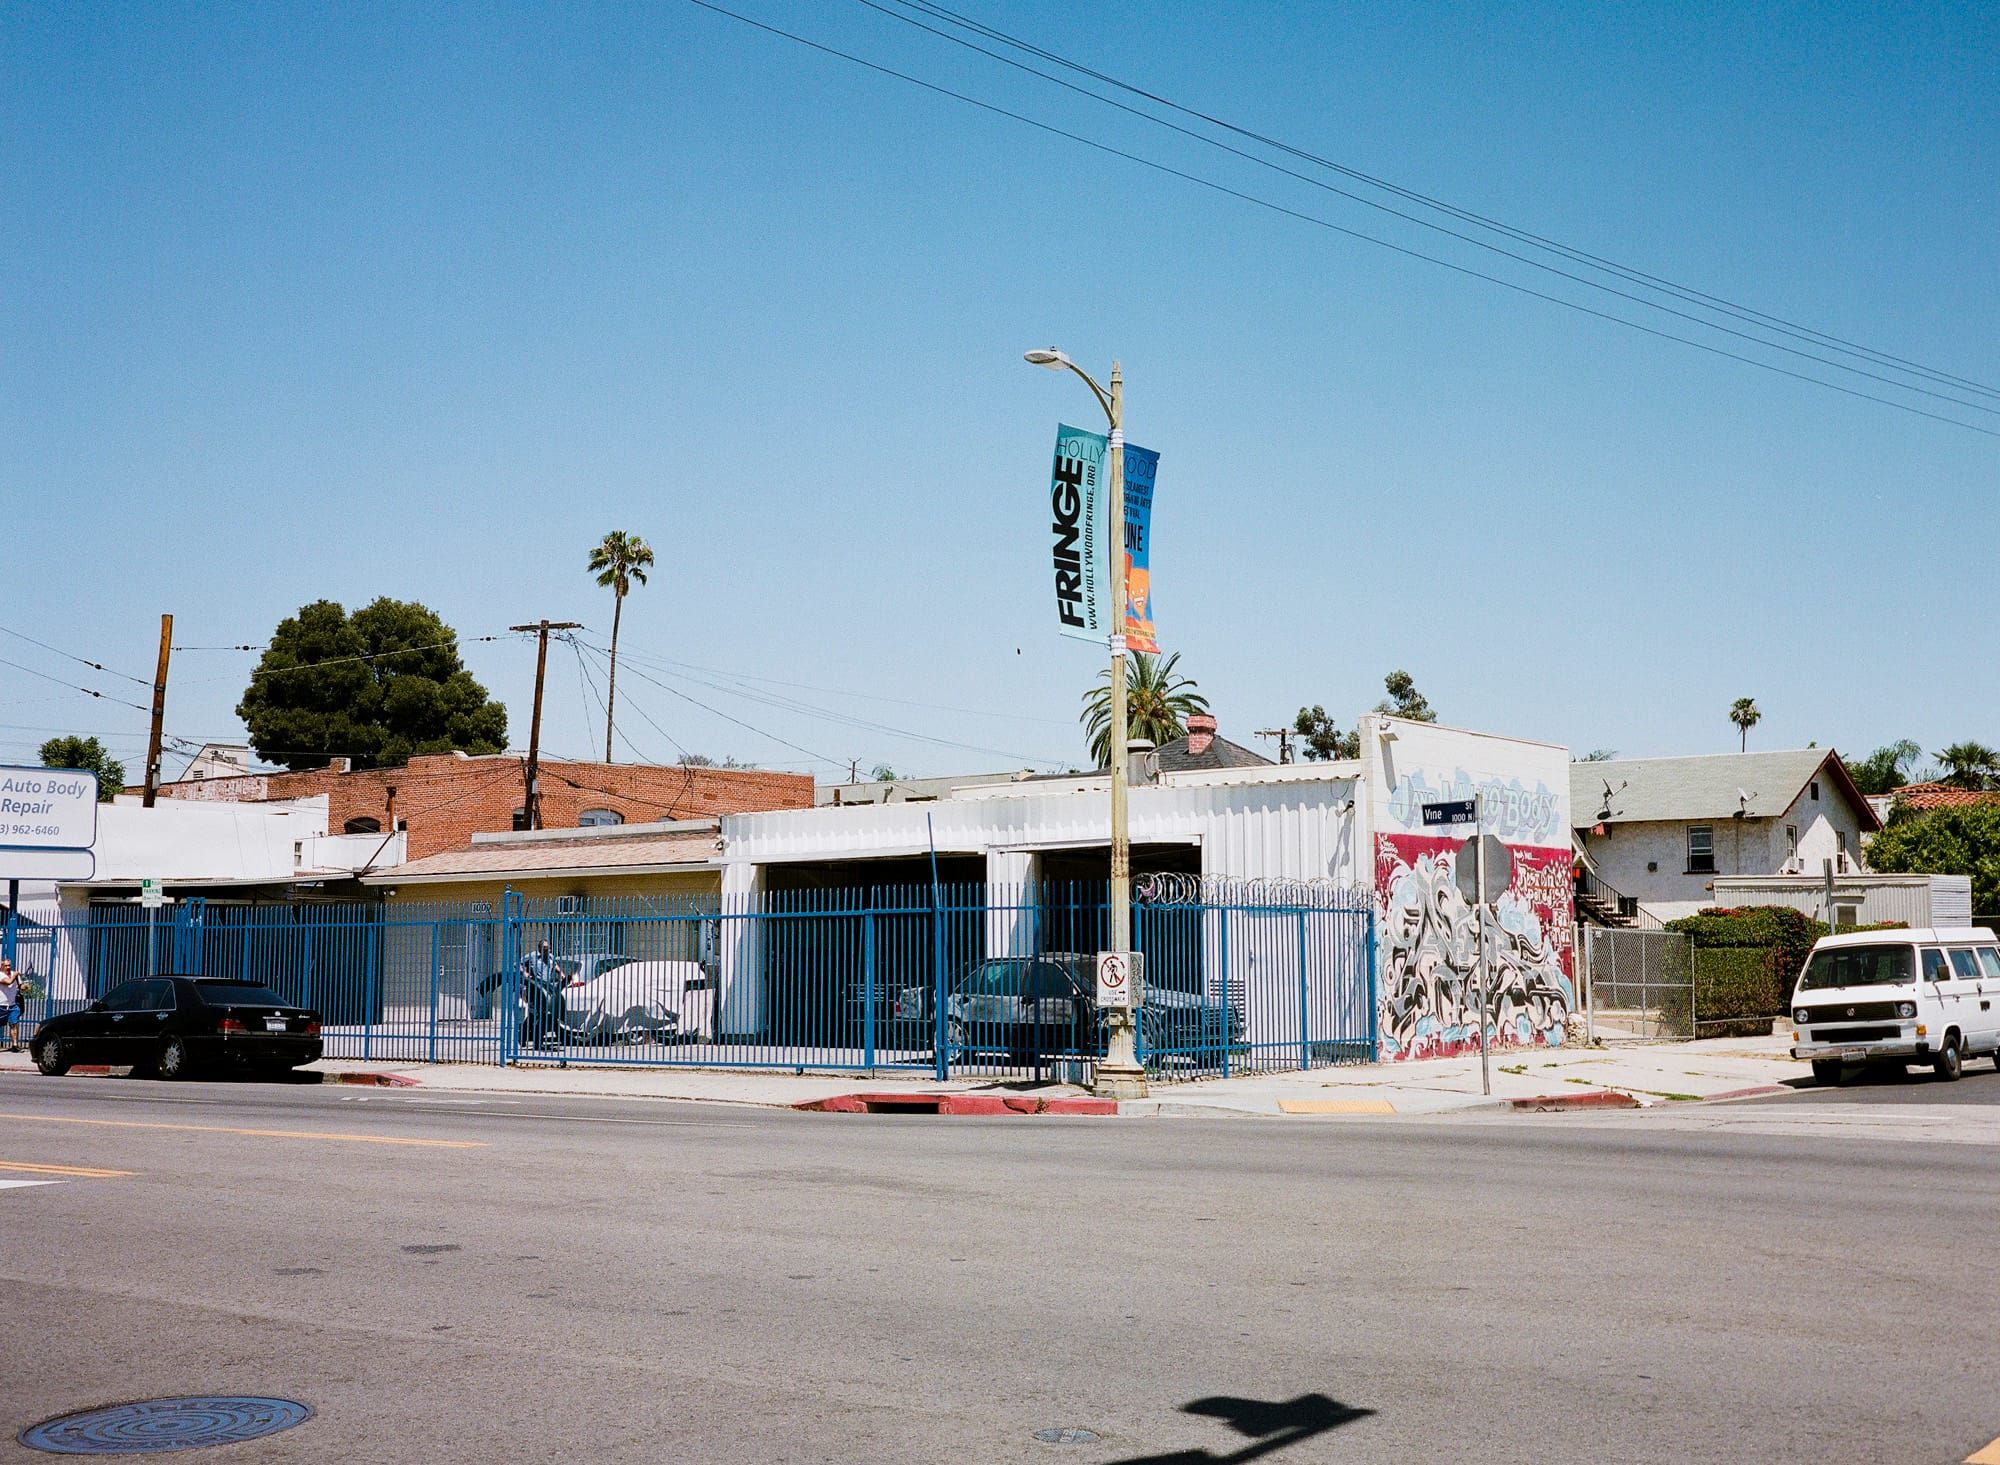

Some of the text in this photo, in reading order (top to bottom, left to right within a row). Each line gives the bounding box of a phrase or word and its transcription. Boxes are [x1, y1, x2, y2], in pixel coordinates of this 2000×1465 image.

[1057, 438, 1106, 464] HOLLY
[1125, 456, 1157, 479] OOD
[1052, 454, 1085, 628] FRINGE
[1124, 521, 1143, 552] UNE
[1, 779, 87, 799] Auto Body
[1, 798, 53, 816] Repair
[1424, 802, 1472, 820] Vine St
[1451, 813, 1473, 822] 1000 N
[12, 825, 60, 836] 962-6460
